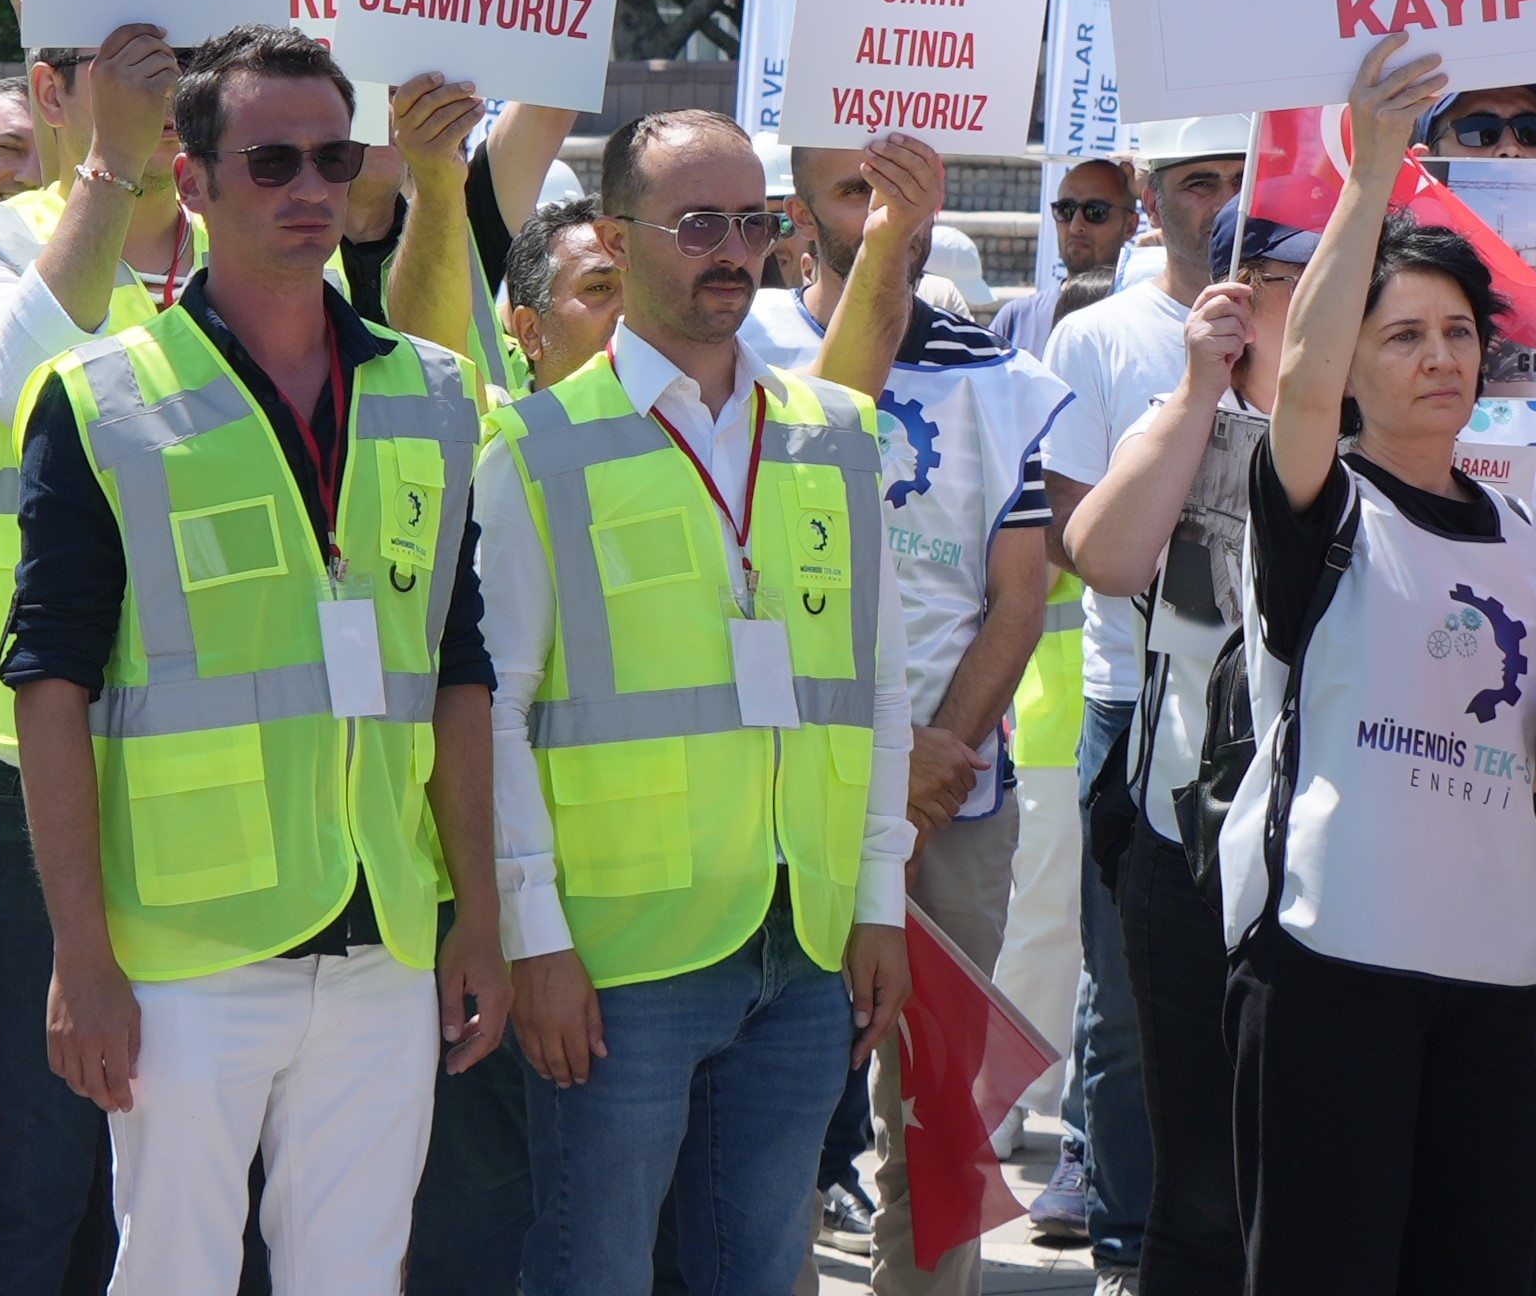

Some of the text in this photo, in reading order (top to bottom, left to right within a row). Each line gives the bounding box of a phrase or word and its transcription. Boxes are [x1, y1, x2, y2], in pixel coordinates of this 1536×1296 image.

[856, 26, 976, 70] ALTINDA
[832, 87, 989, 134] YAŞIYORUZ
[1066, 22, 1095, 156] ANIMLAR
[1461, 457, 1511, 479] BARAJI
[888, 526, 962, 567] TEK-SEN
[1357, 718, 1534, 785] MÜHENDİS TEK-S
[1410, 767, 1511, 810] ENERJİ
